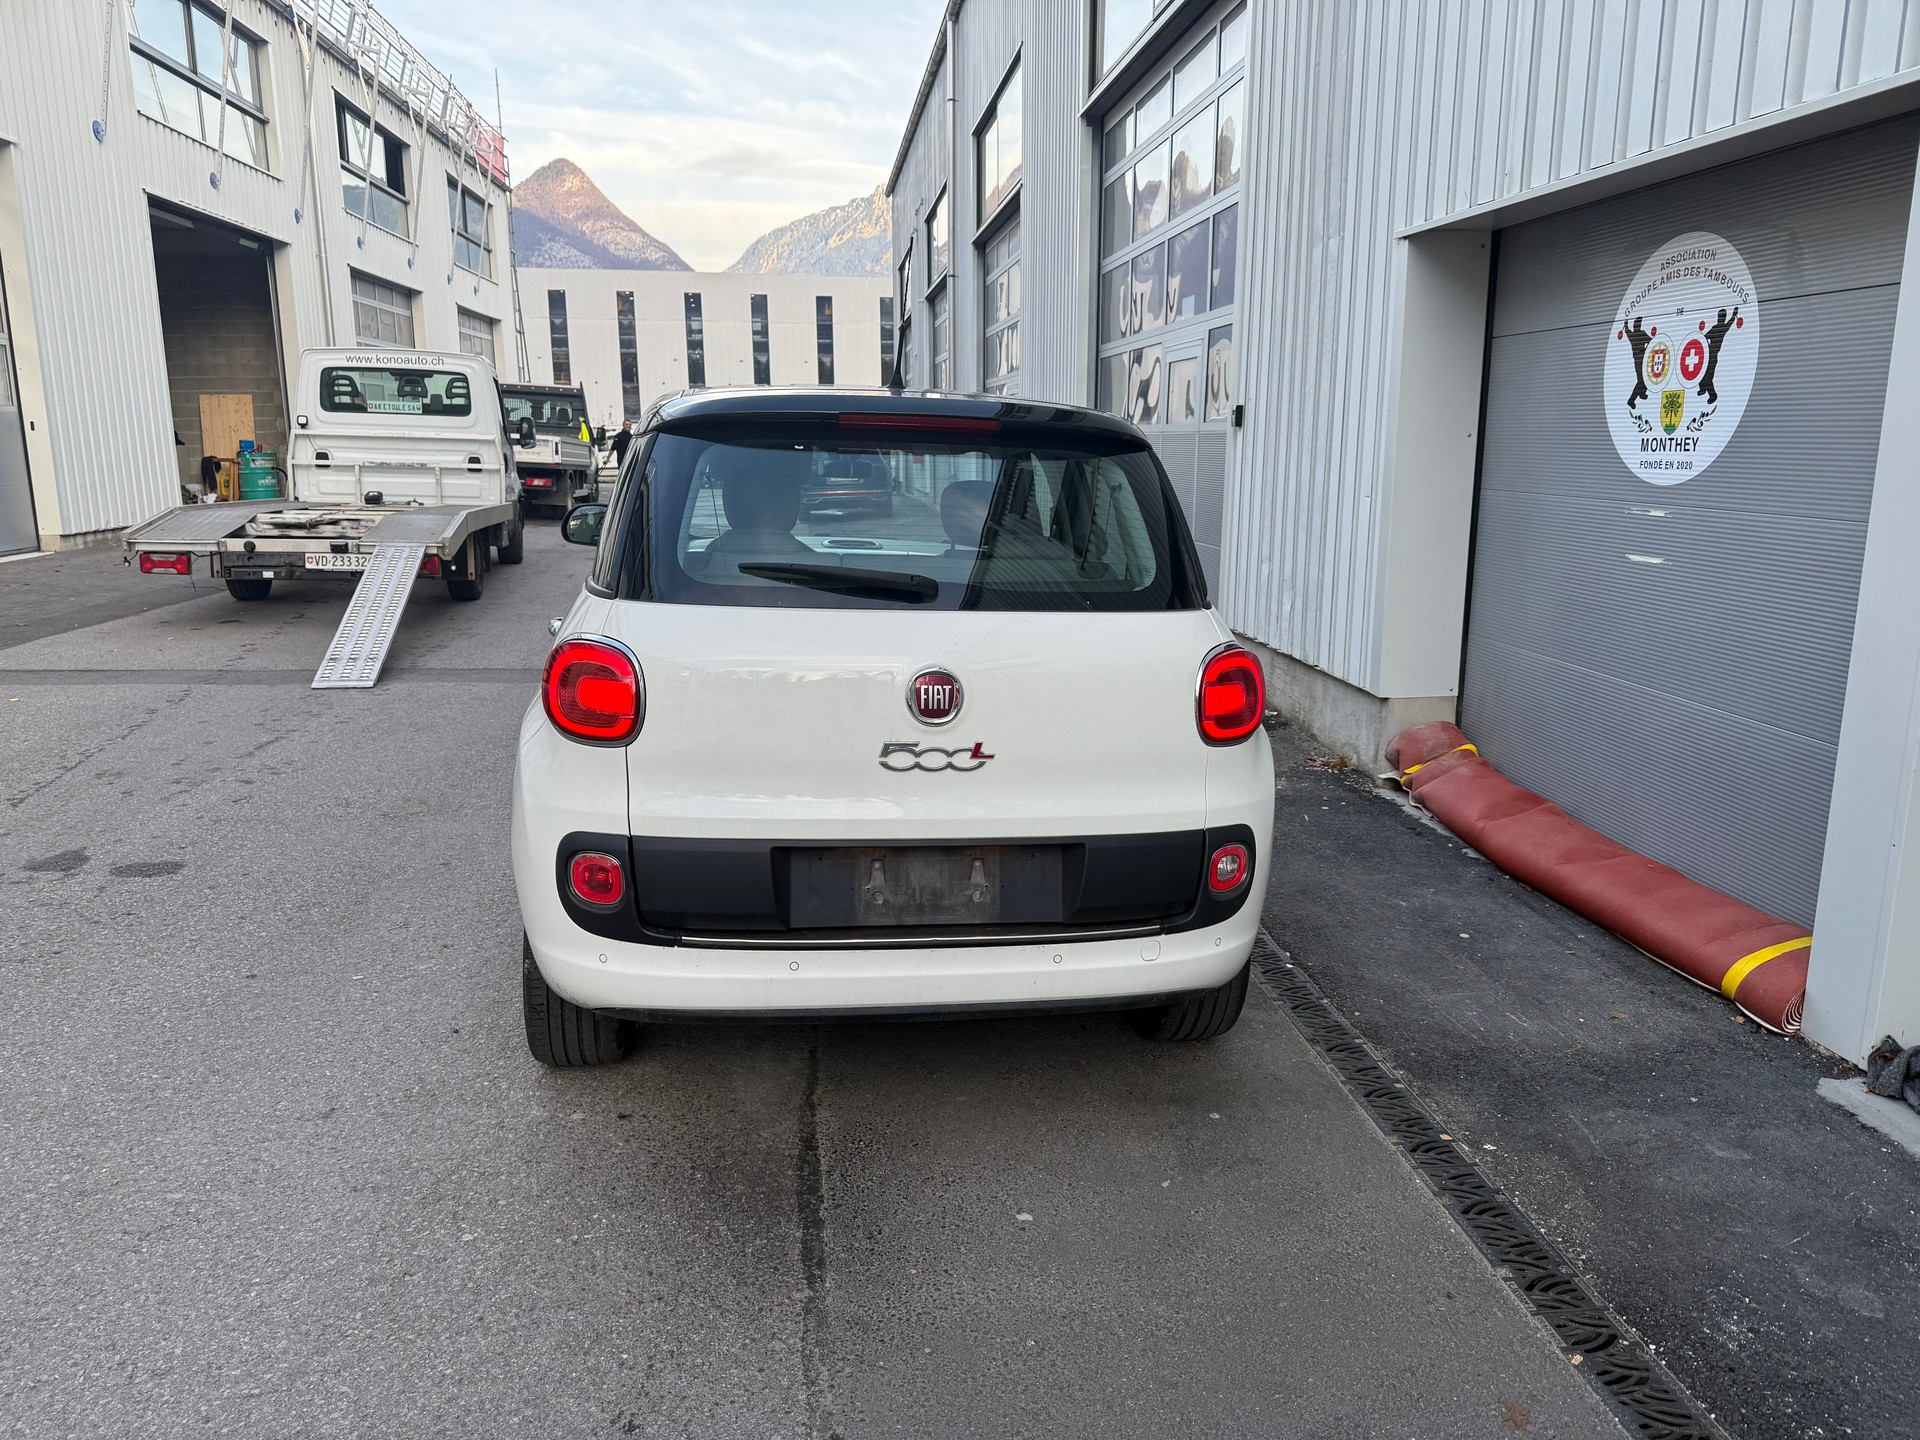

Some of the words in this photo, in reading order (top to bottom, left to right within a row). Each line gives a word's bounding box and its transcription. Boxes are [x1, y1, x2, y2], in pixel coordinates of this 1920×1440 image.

[1660, 249, 1718, 272] ASSOCIATION
[1624, 279, 1658, 317] GROUPE
[1659, 268, 1681, 287] AMIS
[1683, 266, 1701, 278] DES
[1703, 267, 1750, 304] TAMBOURS
[1675, 307, 1685, 317] DE
[345, 354, 445, 367] www.konoauto.ch
[1640, 436, 1700, 453] MONTHEY
[1640, 458, 1663, 470] FONDÉ
[1664, 461, 1675, 470] EN
[1676, 461, 1693, 470] 2020
[314, 555, 328, 567] VD
[354, 556, 371, 568] 32
[920, 684, 952, 710] FIAT
[878, 740, 996, 773] 500L
